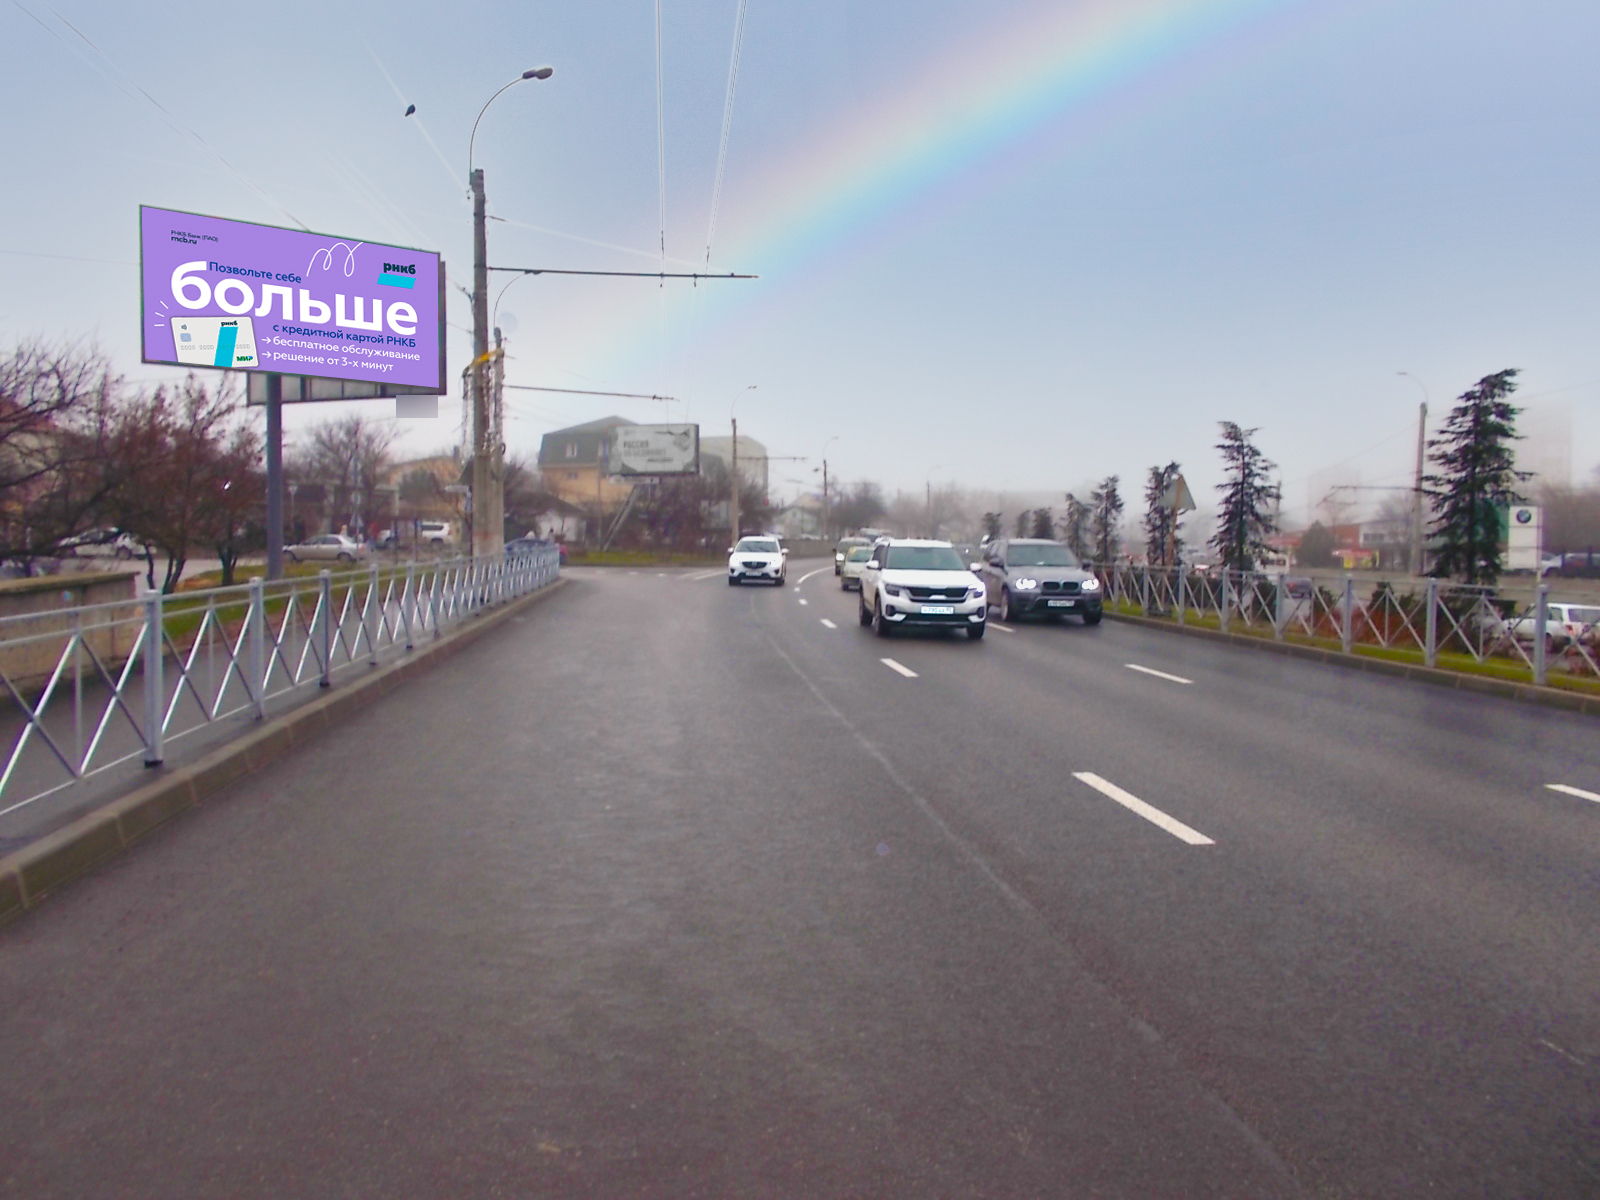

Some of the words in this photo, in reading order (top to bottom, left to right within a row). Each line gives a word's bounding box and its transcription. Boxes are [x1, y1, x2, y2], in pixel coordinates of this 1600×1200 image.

[170, 229, 187, 237] РНКБ
[202, 234, 219, 243] (ПАО)
[170, 236, 198, 245] rncb.ru
[209, 261, 273, 279] Позвольте
[275, 273, 302, 283] себе
[383, 262, 417, 275] рнкб
[171, 260, 419, 336] больше
[272, 324, 280, 332] с
[282, 324, 344, 340] кредитной
[346, 332, 384, 345] картой
[386, 335, 416, 348] РНКБ
[272, 335, 339, 352] бесплатное
[341, 344, 421, 361] обслуживание
[273, 351, 325, 364] решение
[327, 357, 339, 365] от
[341, 356, 359, 368] 3-х
[361, 361, 394, 373] минут
